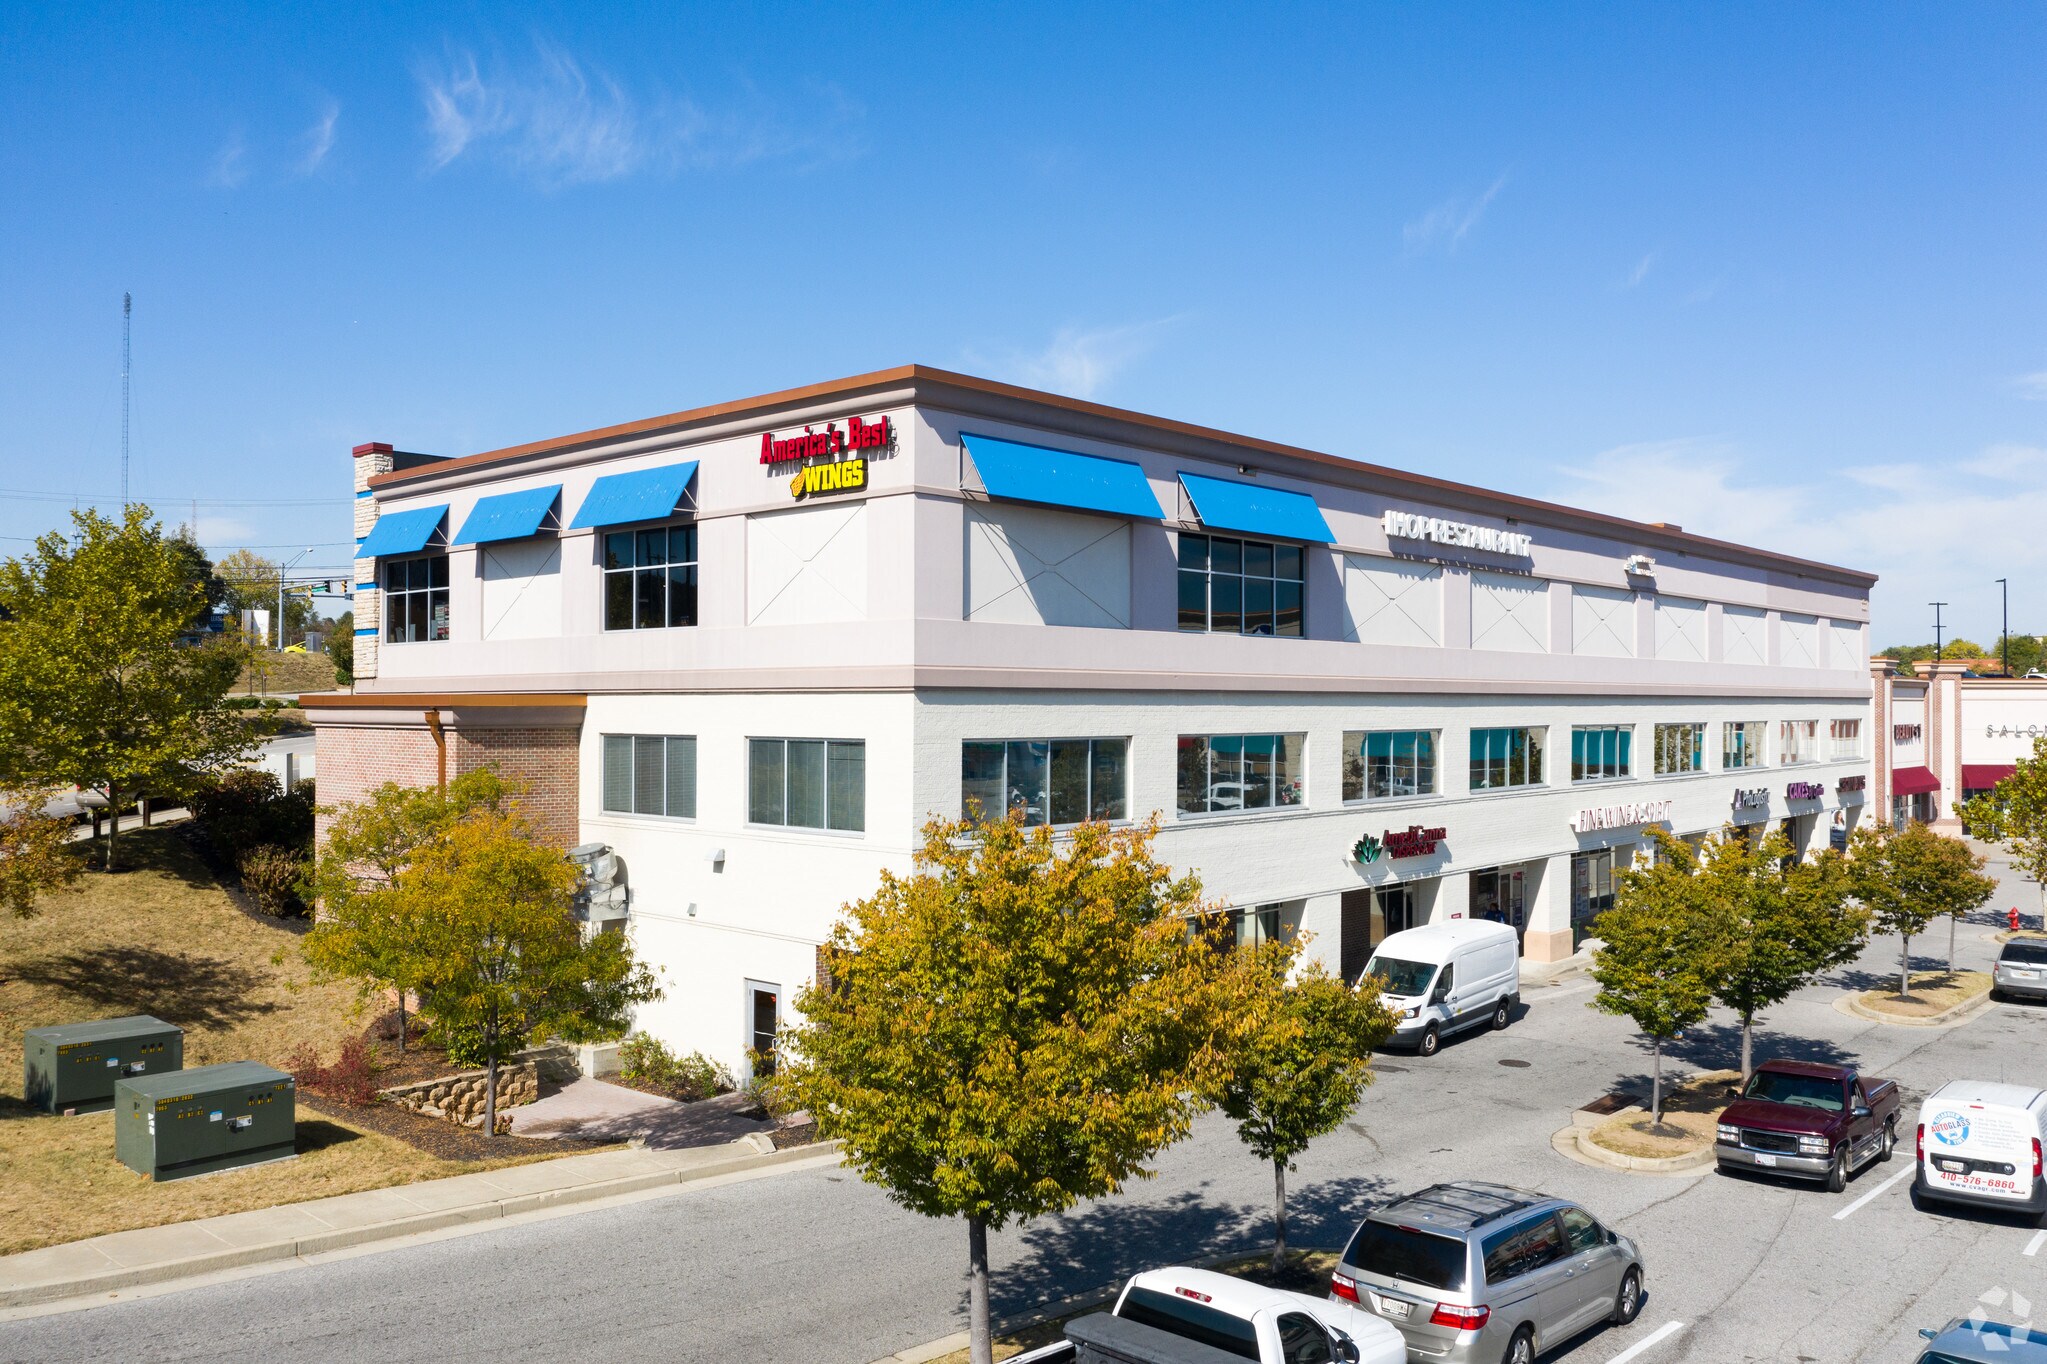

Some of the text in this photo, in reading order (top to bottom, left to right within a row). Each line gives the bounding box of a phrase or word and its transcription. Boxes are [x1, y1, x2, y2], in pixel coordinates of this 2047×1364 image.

[760, 415, 888, 464] America's Best
[804, 459, 864, 493] WINGS
[1385, 510, 1532, 557] IHOP RESTAURANT
[1576, 808, 1602, 832] FINE
[1603, 804, 1632, 828] WINE
[1931, 1118, 1971, 1133] AUTOGLASS
[1941, 1172, 2015, 1189] 410-576-6860
